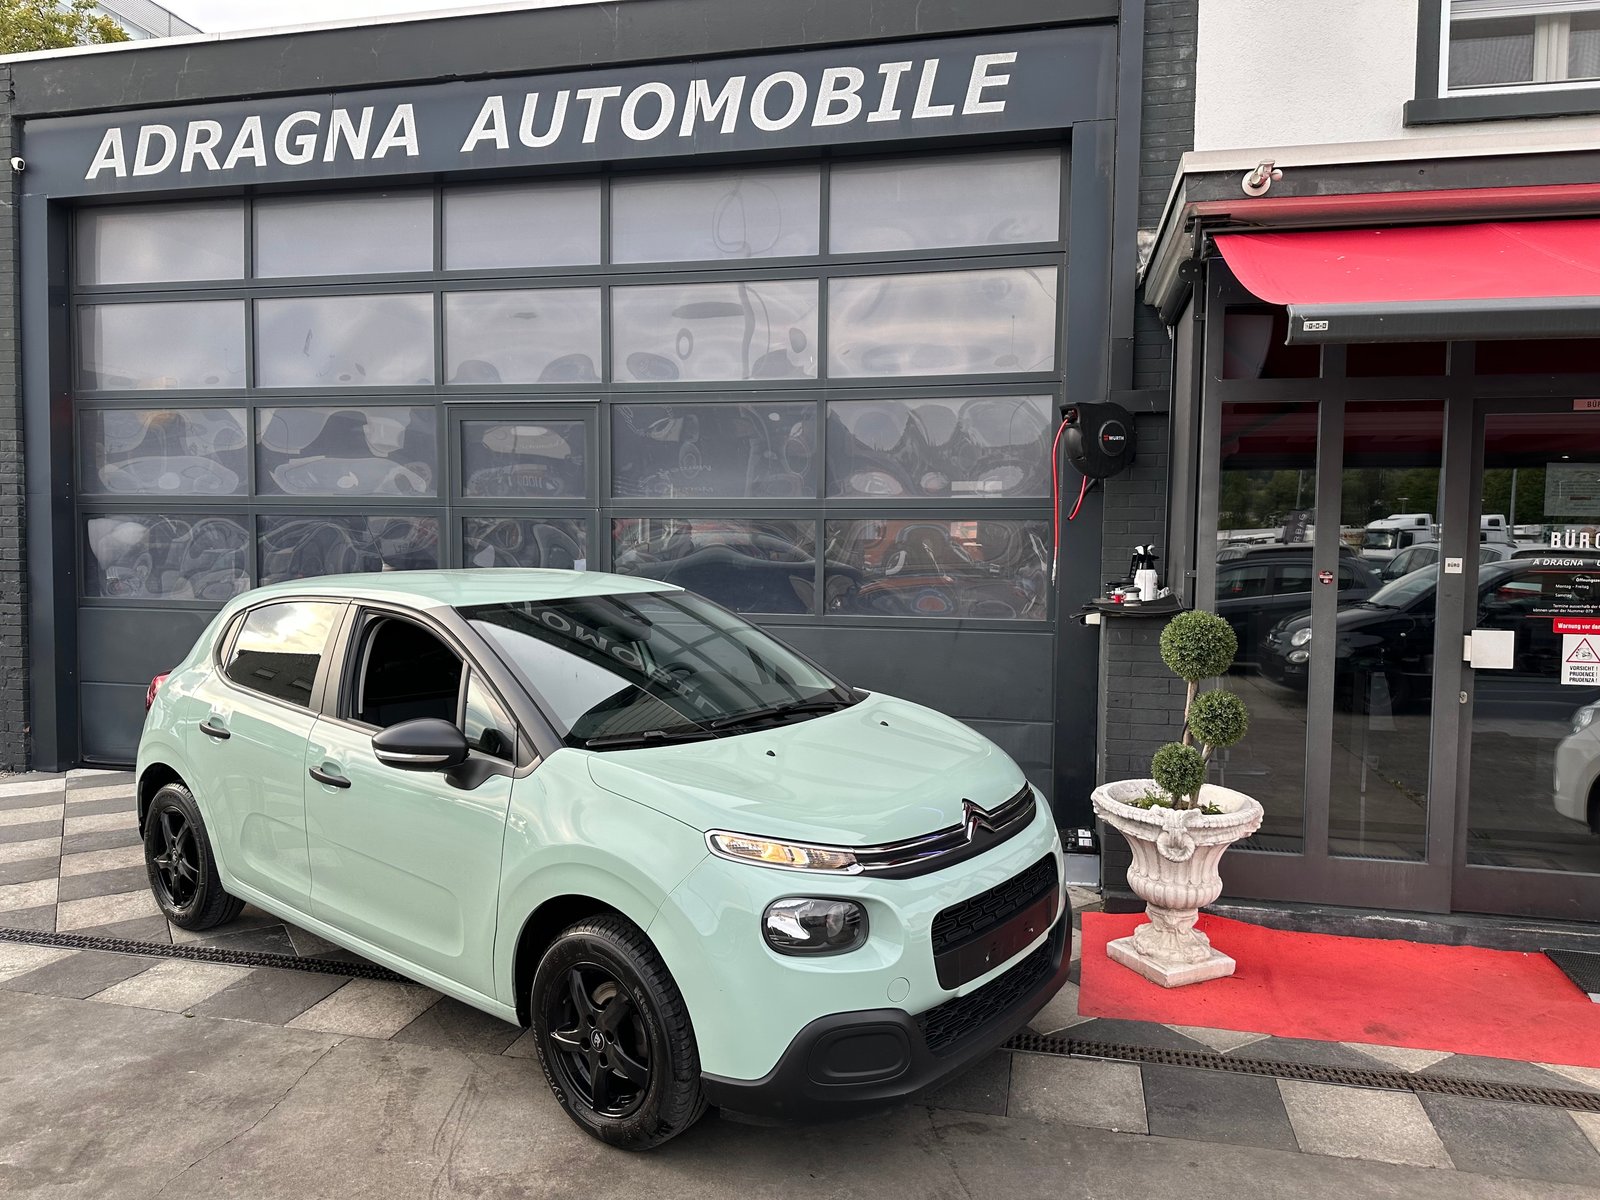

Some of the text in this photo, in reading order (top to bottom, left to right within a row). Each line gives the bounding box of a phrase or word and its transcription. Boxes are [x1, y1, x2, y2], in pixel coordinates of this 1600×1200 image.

[84, 51, 1018, 180] ADRAGNA AUTOMOBILE
[1557, 622, 1581, 630] Warnung
